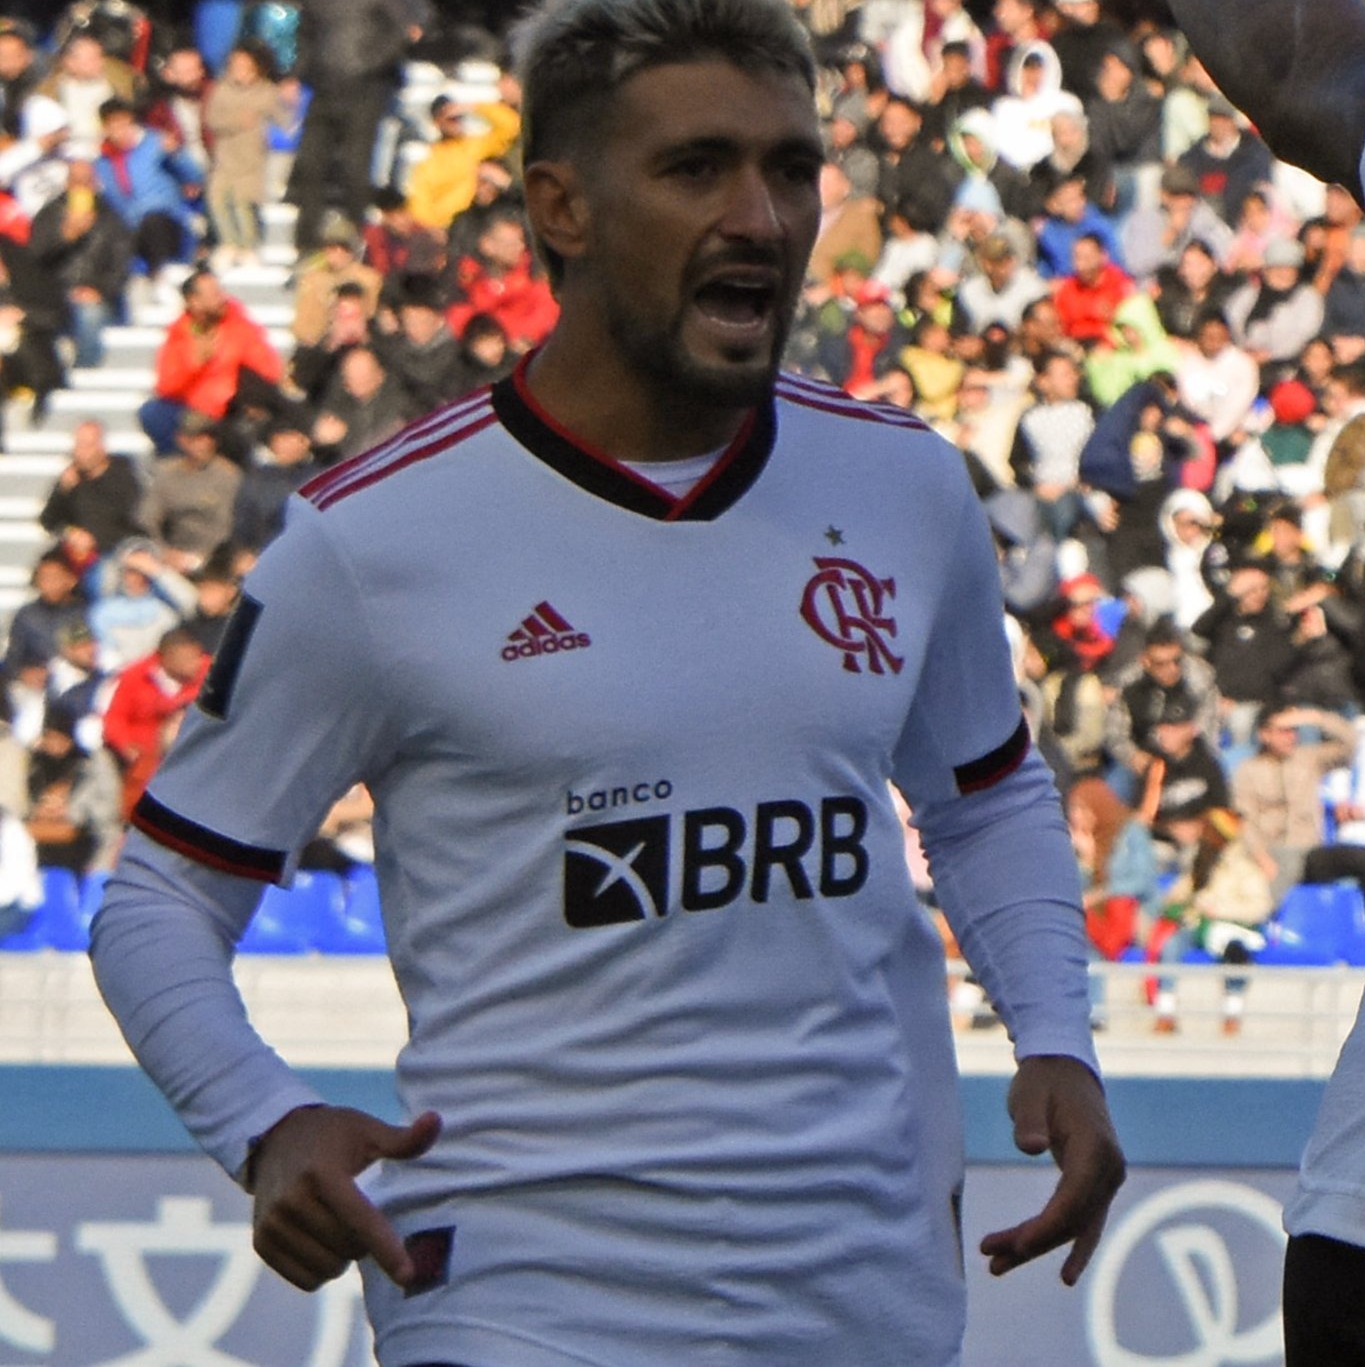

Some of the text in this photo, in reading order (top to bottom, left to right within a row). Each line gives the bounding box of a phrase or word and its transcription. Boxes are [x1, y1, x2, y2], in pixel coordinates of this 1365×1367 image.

[501, 632, 592, 661] adidas
[566, 779, 673, 815] banco
[682, 796, 870, 912] BRB
